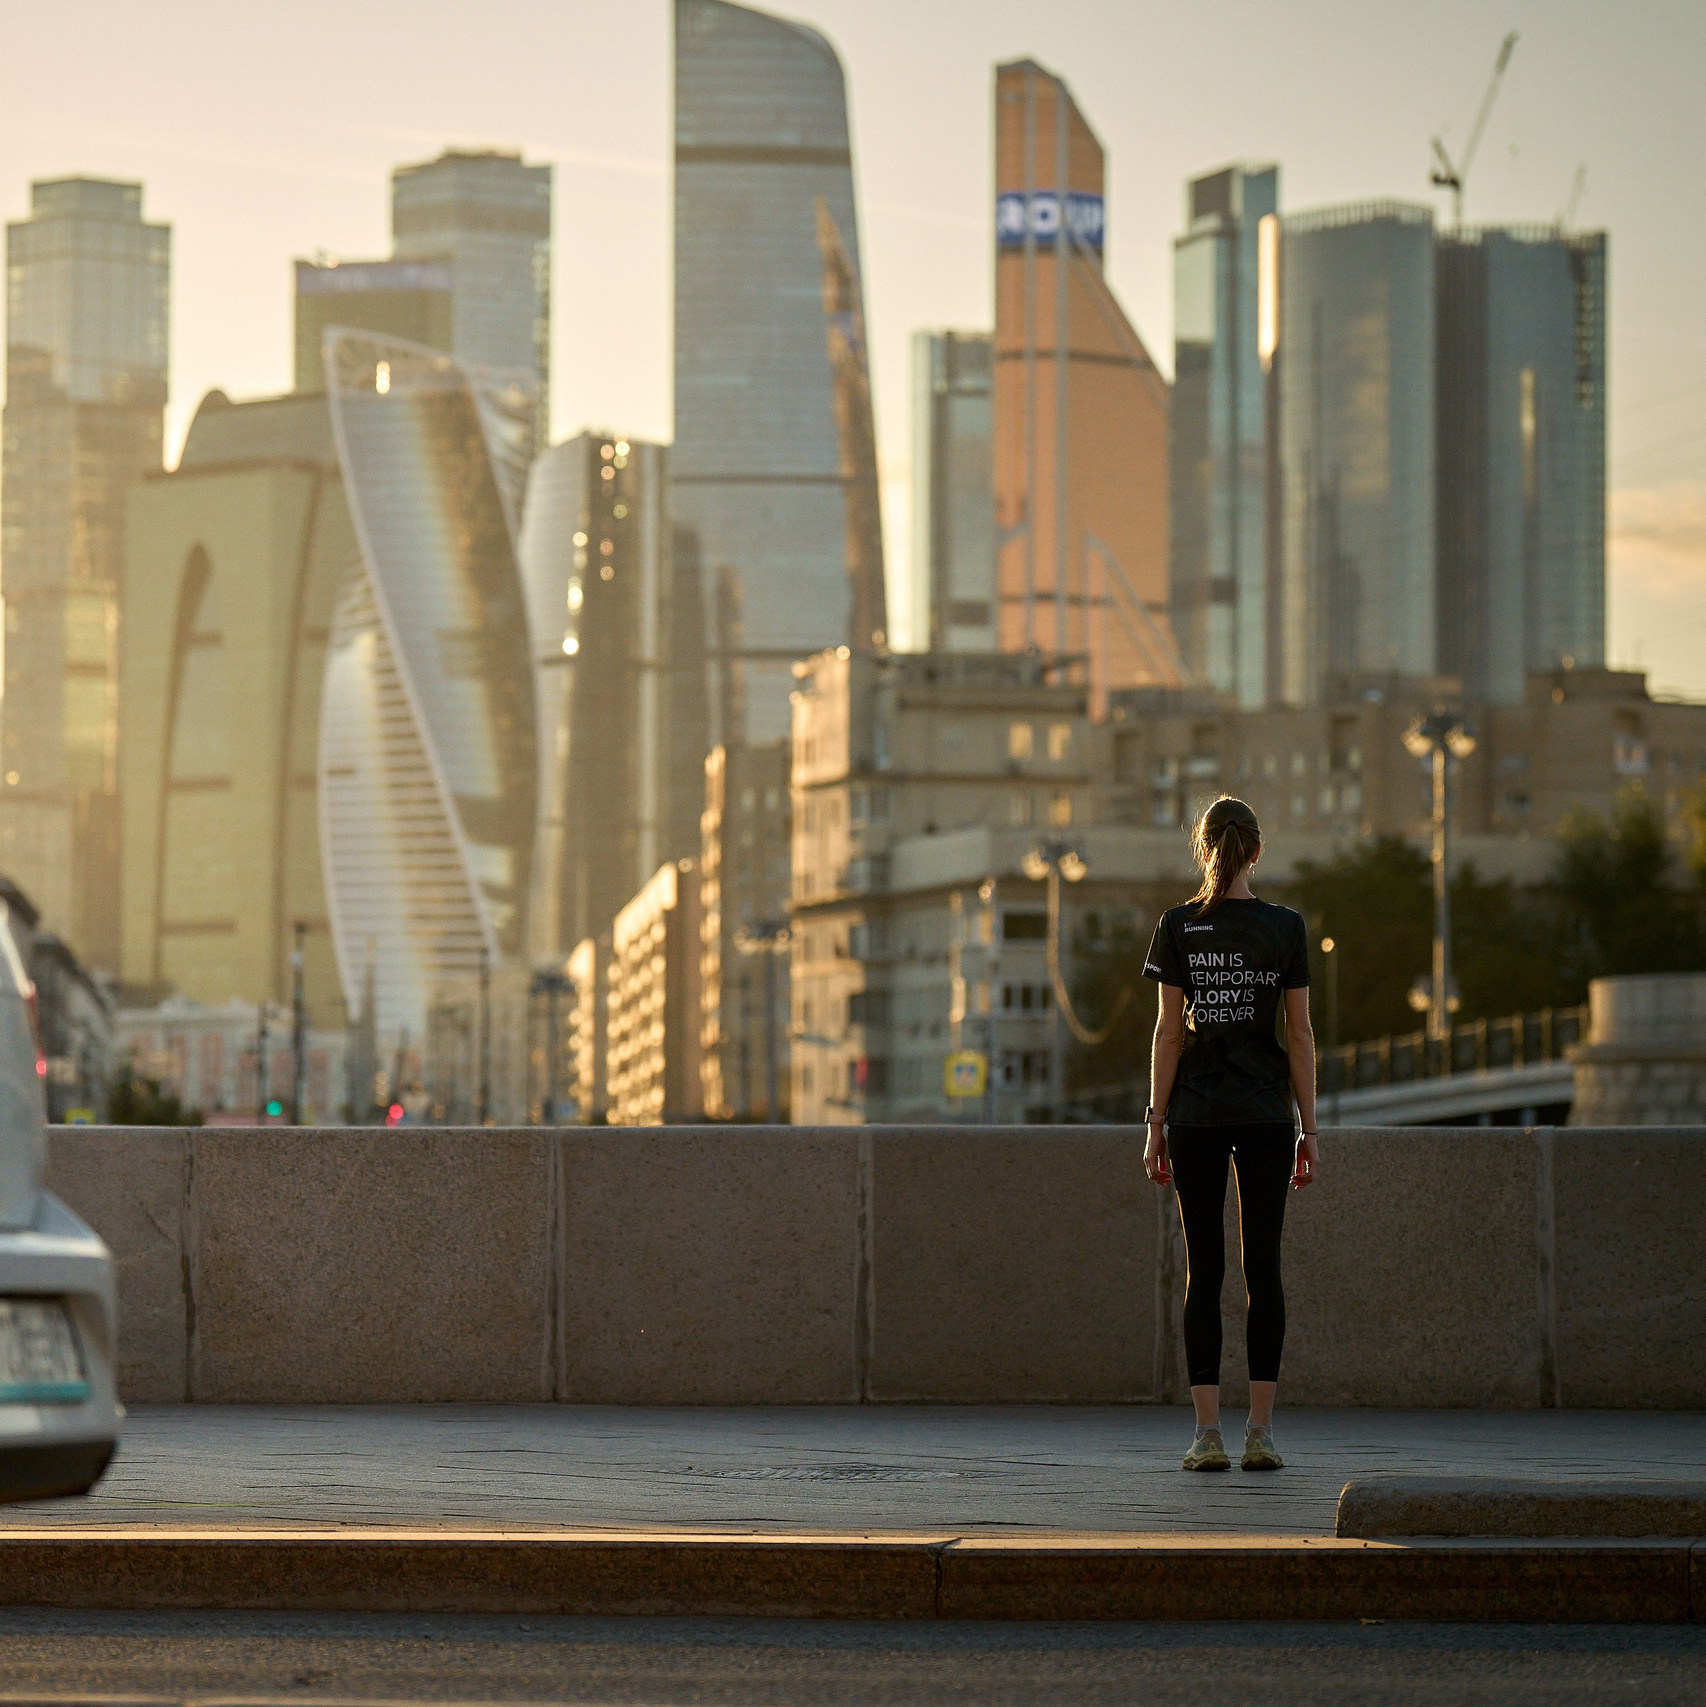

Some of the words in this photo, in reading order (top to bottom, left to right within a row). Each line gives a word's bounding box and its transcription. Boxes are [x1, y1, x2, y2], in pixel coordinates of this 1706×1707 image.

[1188, 953, 1225, 967] PAIN
[1229, 953, 1243, 967] IS
[1190, 971, 1280, 986] TEMPORAR
[1242, 989, 1255, 1002] IS
